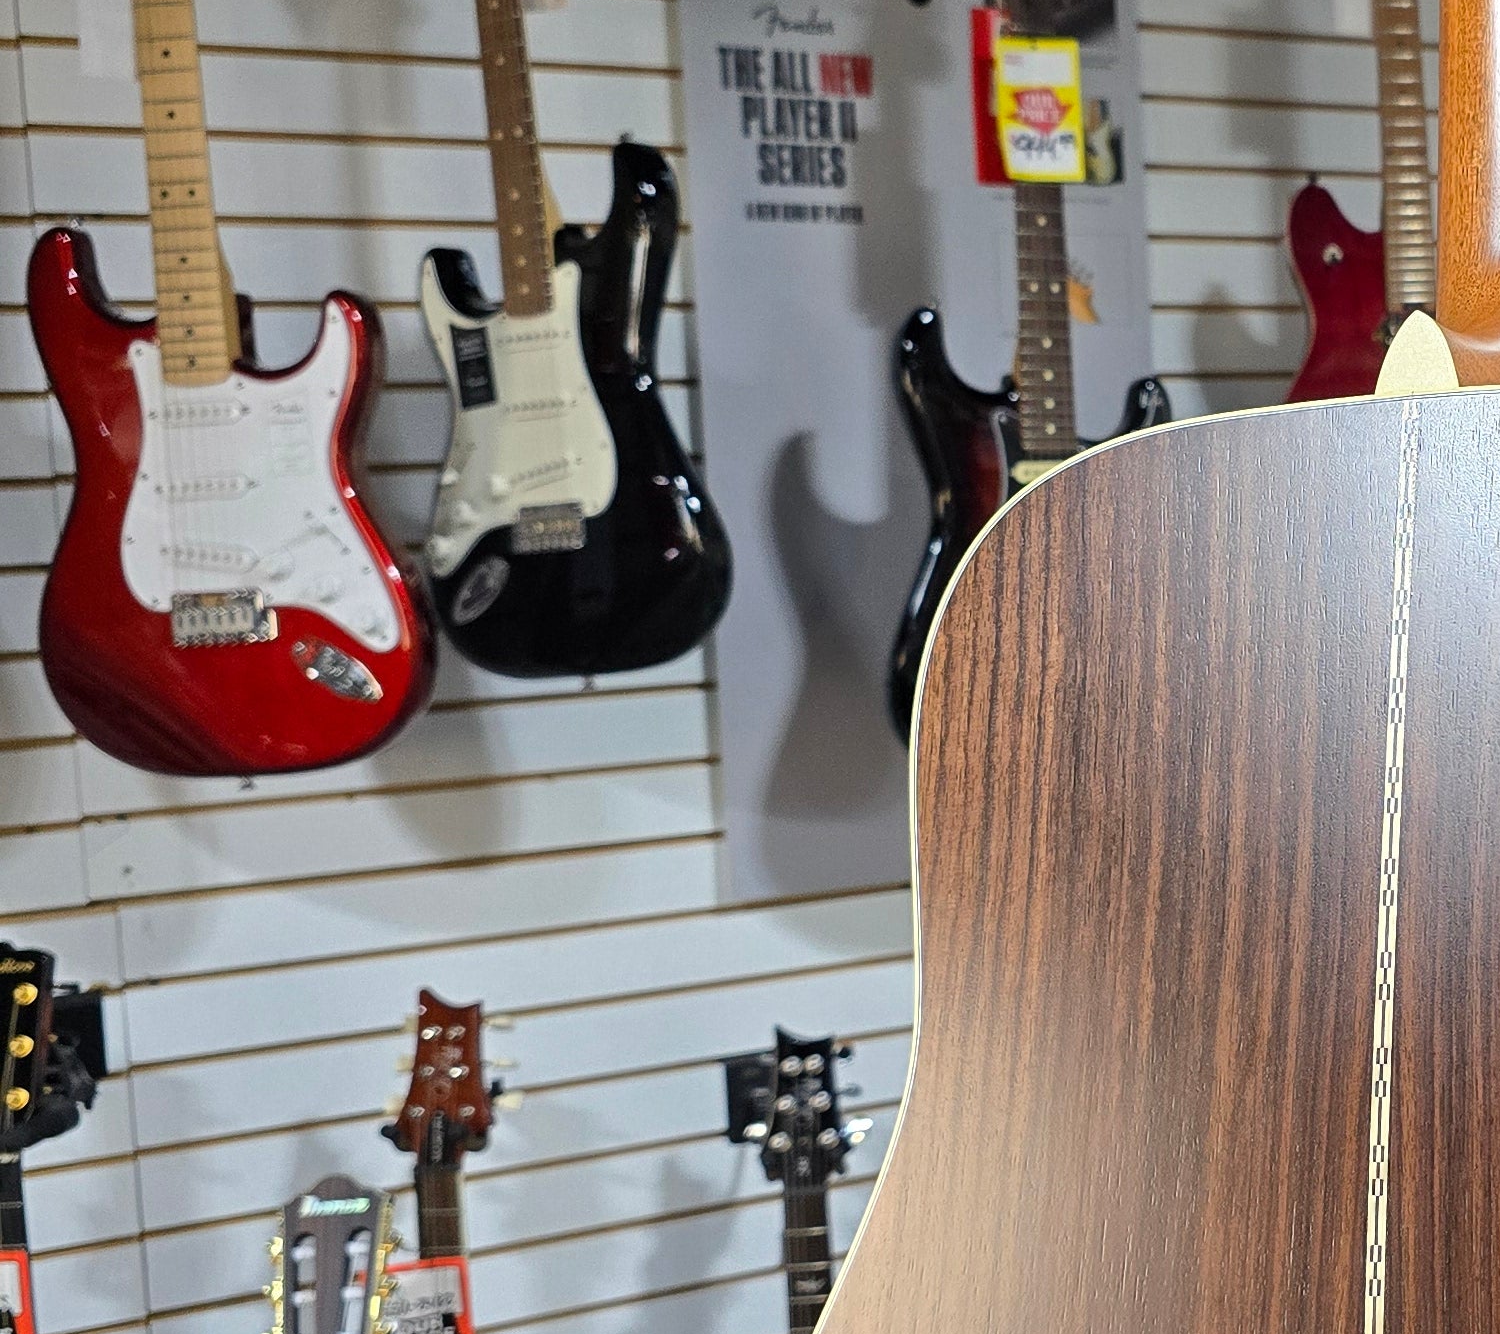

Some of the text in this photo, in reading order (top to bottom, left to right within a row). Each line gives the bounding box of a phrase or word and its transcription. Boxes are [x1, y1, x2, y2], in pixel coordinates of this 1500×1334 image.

[718, 44, 873, 98] THE ALL NEW
[741, 96, 833, 142] PLAYER
[758, 144, 846, 188] SERIES
